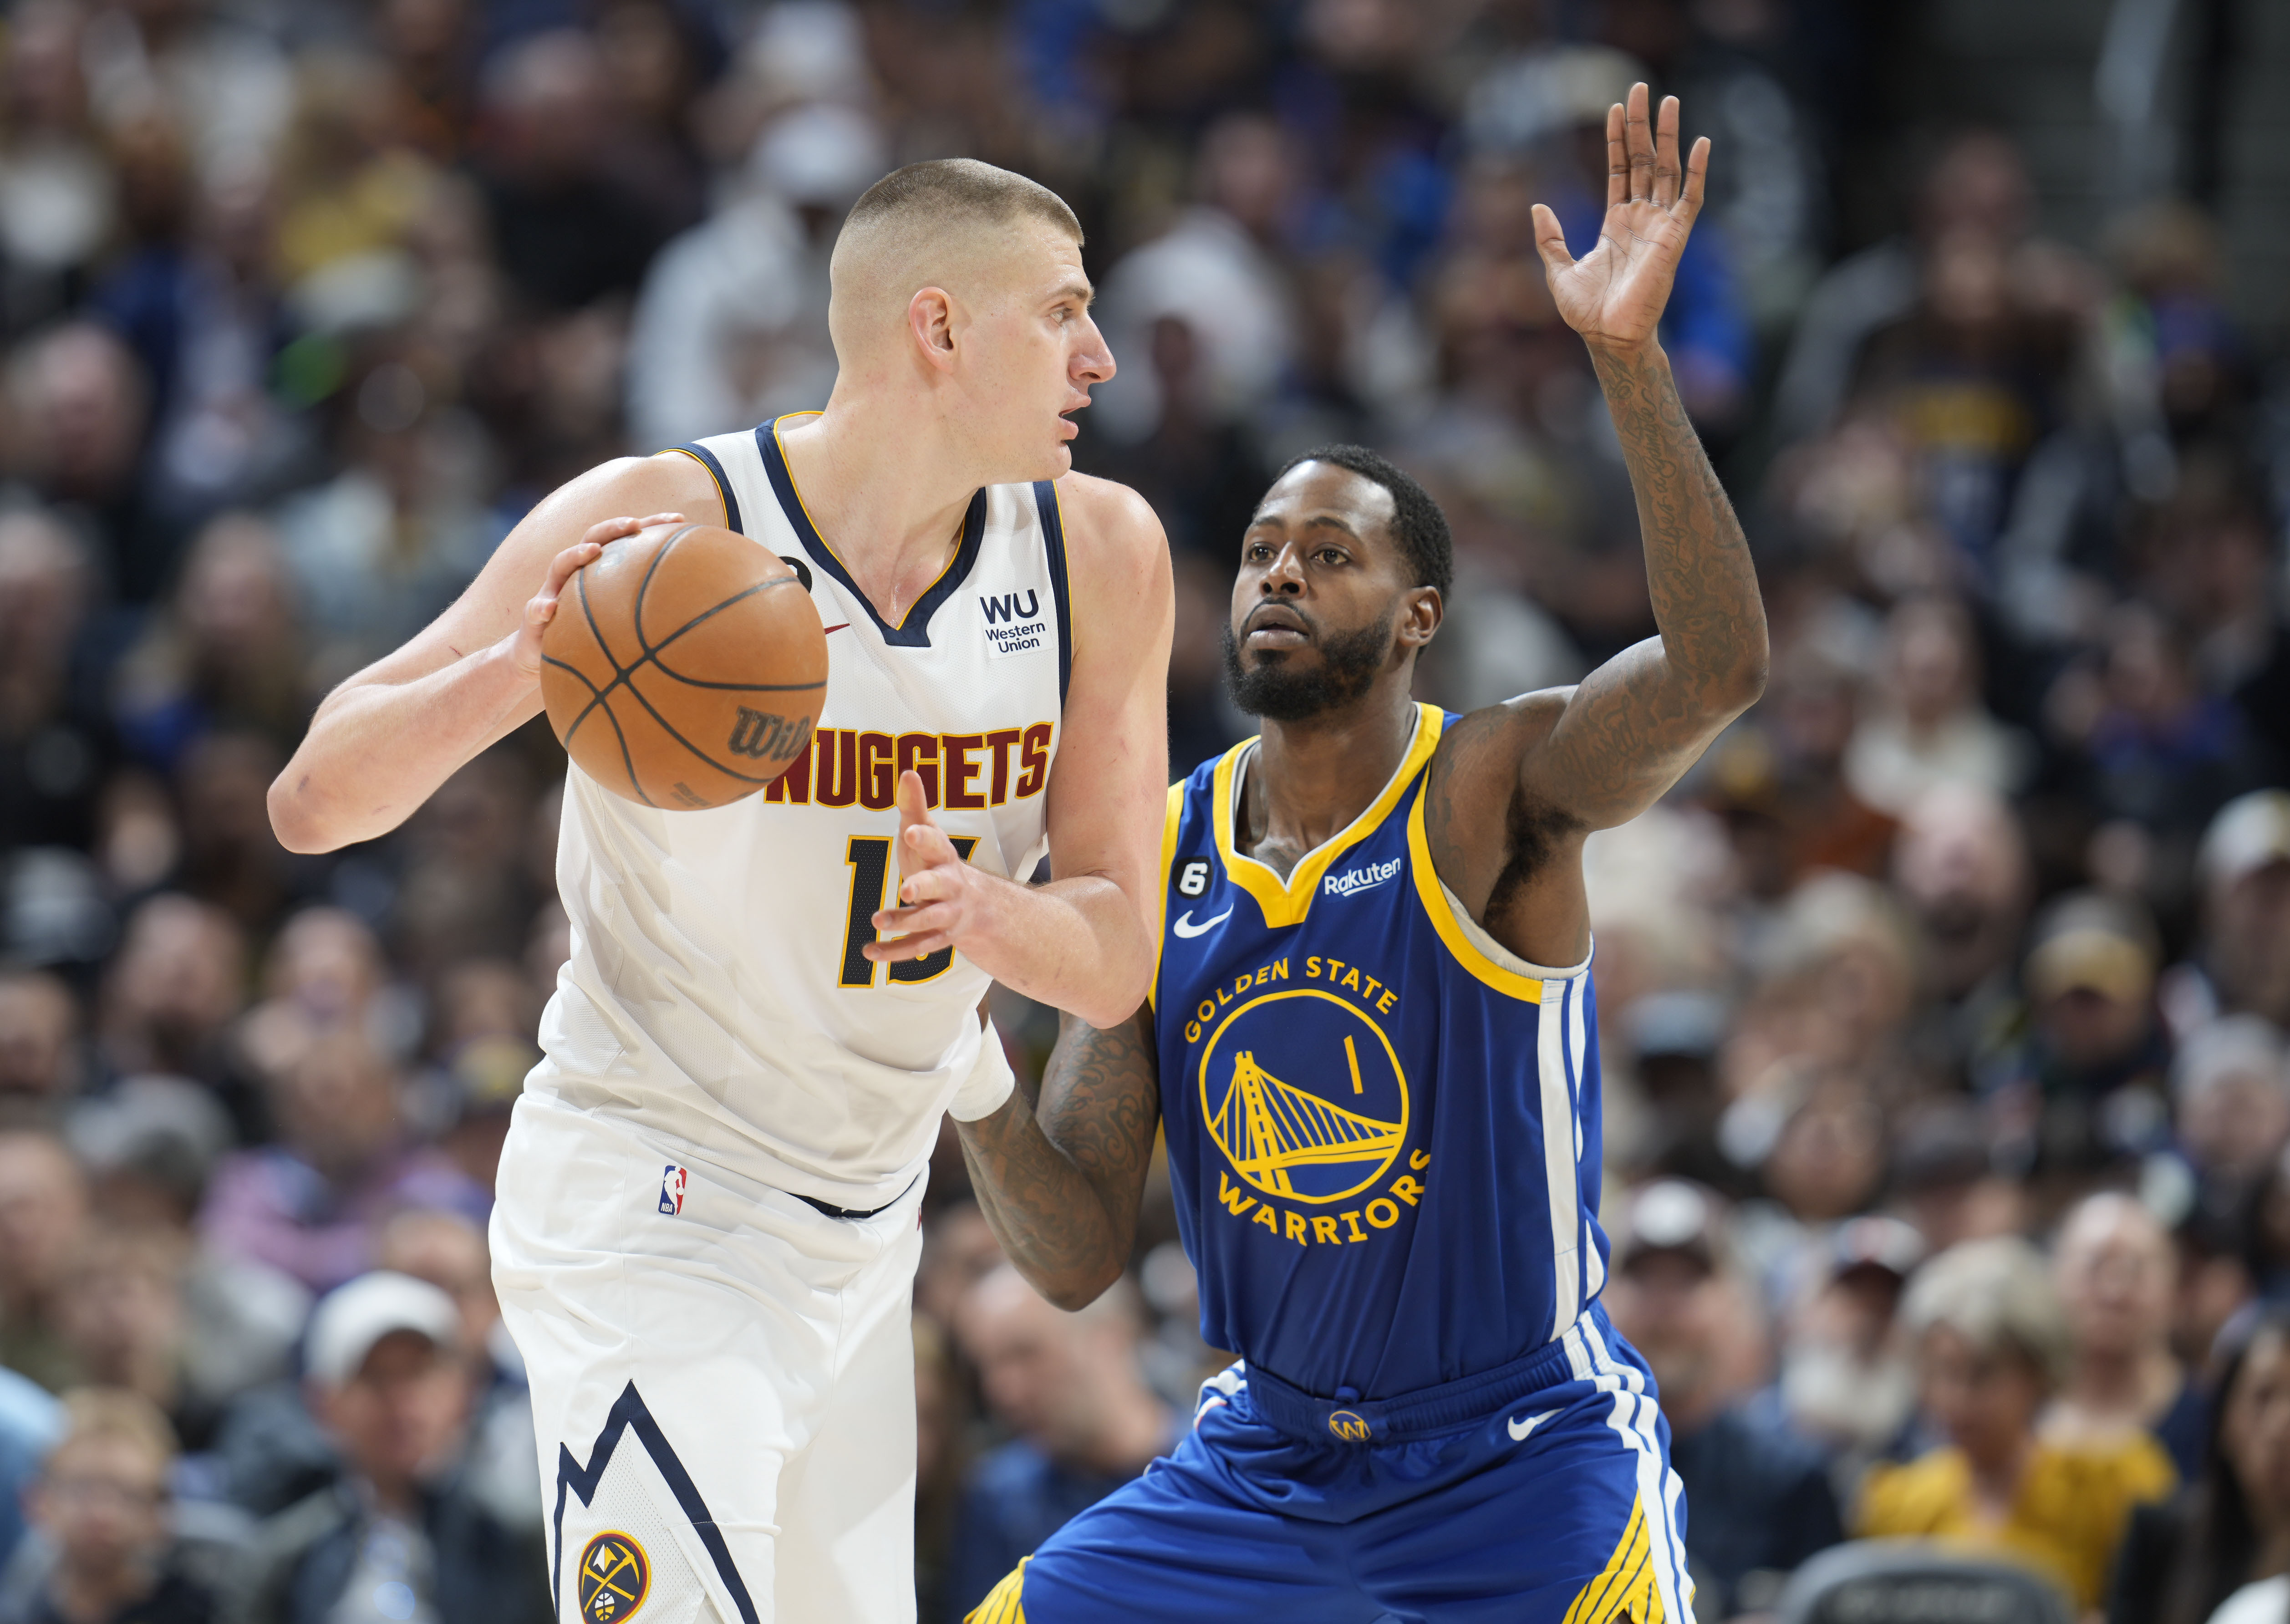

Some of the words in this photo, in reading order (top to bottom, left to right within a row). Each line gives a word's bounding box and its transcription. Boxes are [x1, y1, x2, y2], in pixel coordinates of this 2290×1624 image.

[980, 589, 1039, 624] WU
[985, 623, 1046, 641] Western
[998, 638, 1040, 653] Union
[763, 721, 1054, 812] NUGGETS
[1180, 863, 1208, 896] 6
[1324, 857, 1401, 896] Rakuten
[1184, 957, 1289, 1044] GOLDEN
[1306, 956, 1399, 1015] STATE
[661, 1202, 673, 1213] NBA
[1218, 1148, 1431, 1247] WARRIORS
